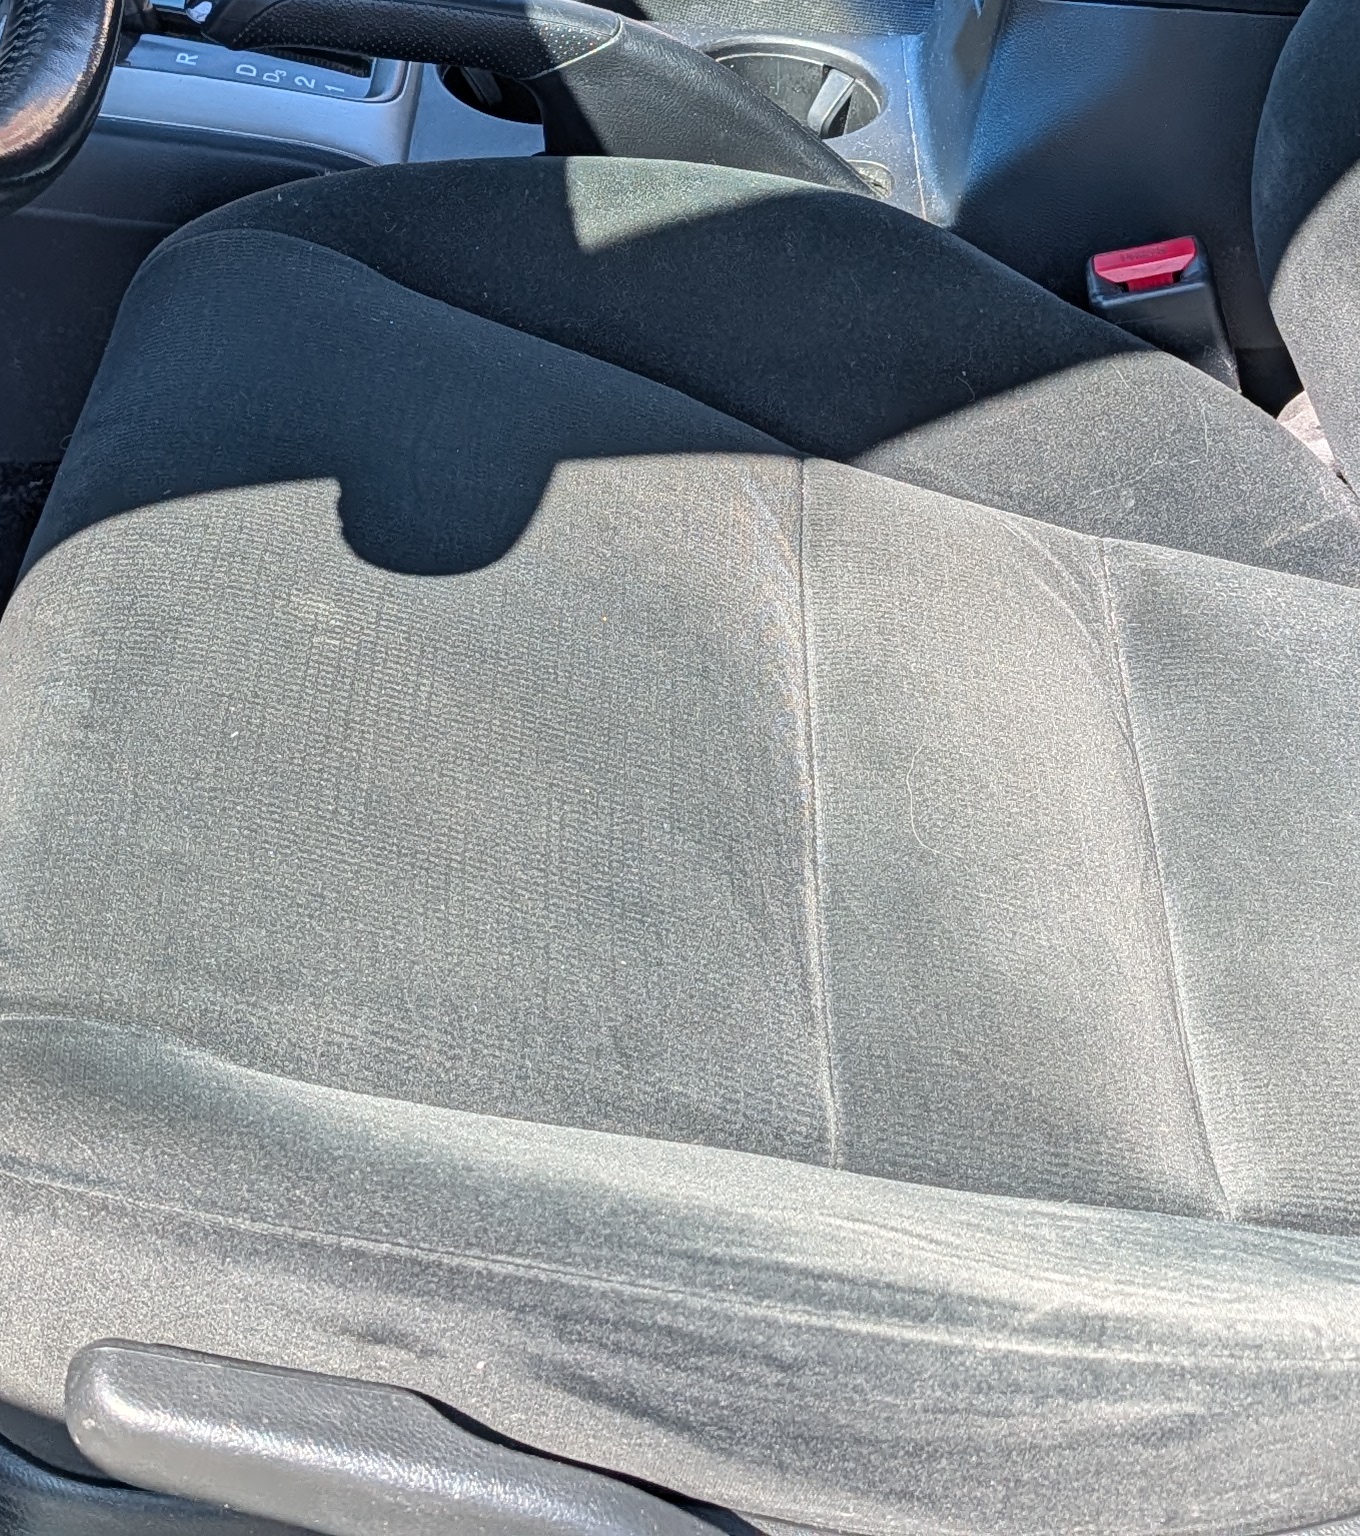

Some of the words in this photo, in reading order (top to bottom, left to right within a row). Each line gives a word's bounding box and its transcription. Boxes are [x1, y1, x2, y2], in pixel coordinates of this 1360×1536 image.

[175, 52, 200, 66] R
[235, 63, 257, 78] D
[294, 75, 316, 89] 2
[325, 83, 345, 93] 1
